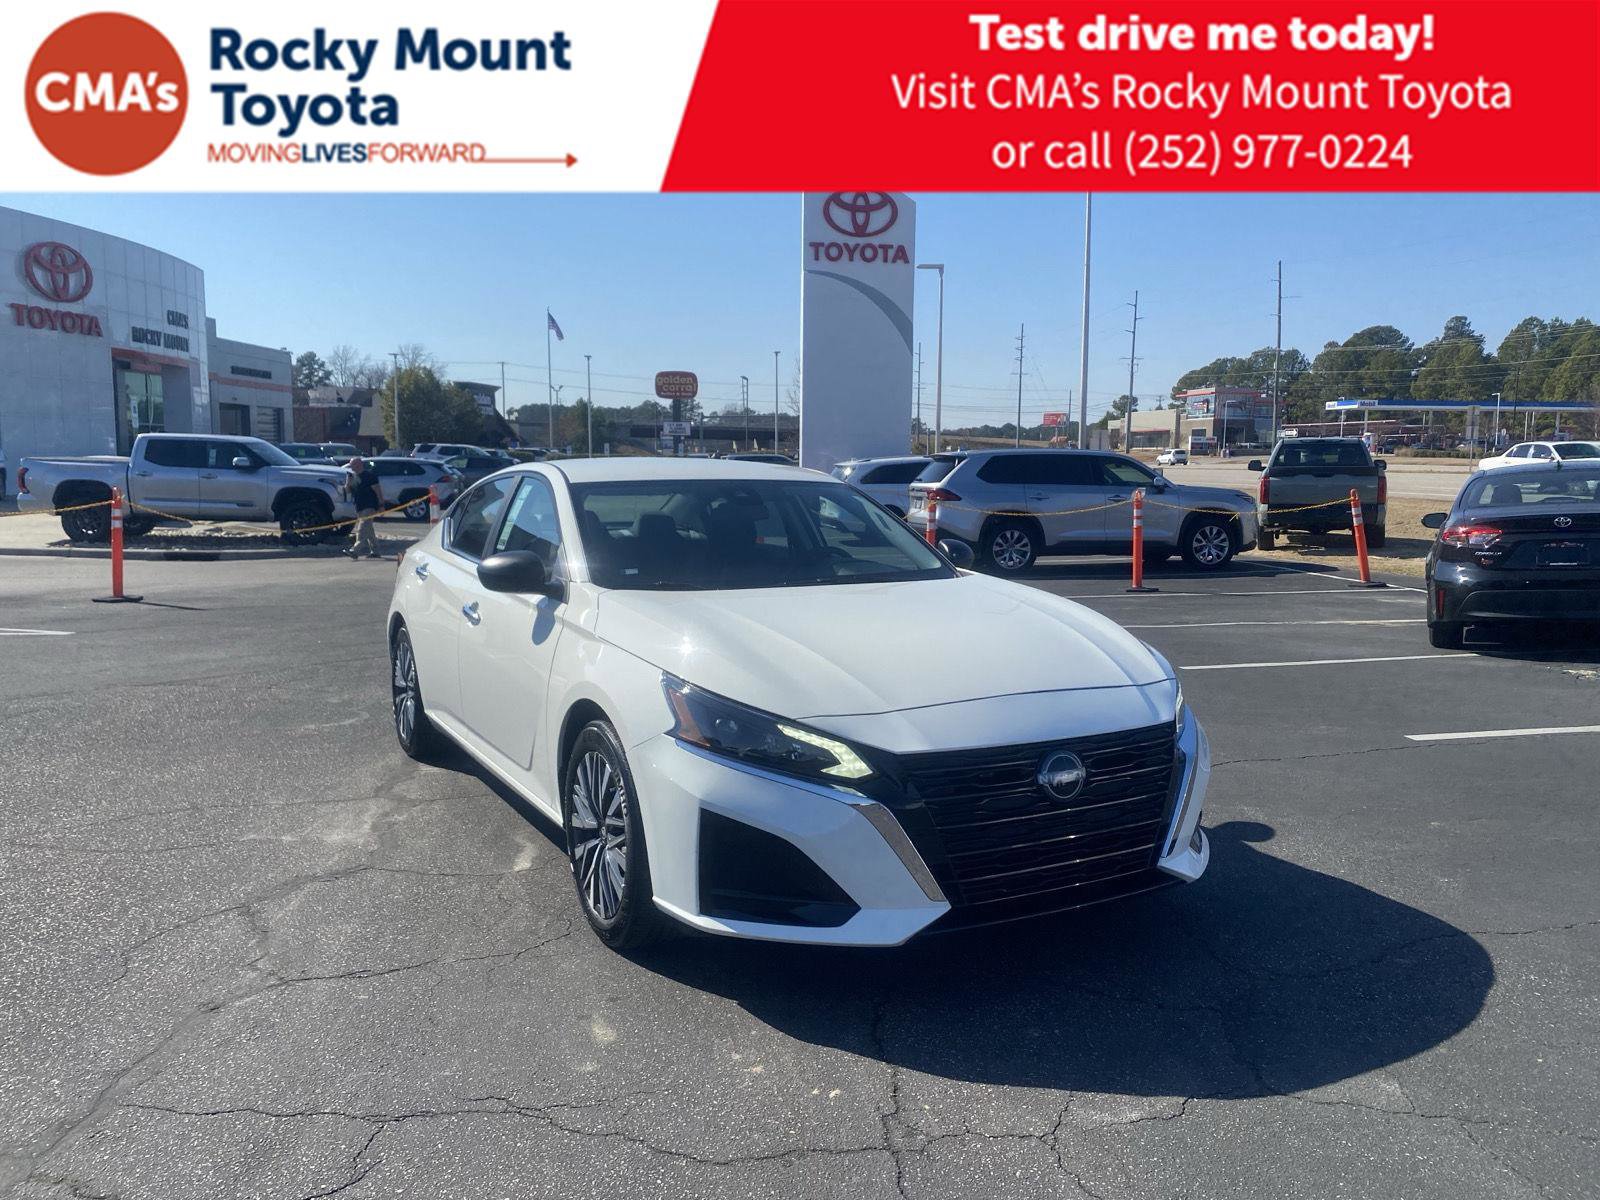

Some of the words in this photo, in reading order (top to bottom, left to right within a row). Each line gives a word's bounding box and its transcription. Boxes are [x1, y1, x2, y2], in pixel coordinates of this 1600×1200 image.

[808, 241, 910, 264] TOYOTA
[9, 303, 103, 337] TOYOTA
[131, 326, 162, 347] ROCKY
[656, 376, 693, 385] golden
[662, 383, 696, 391] corral
